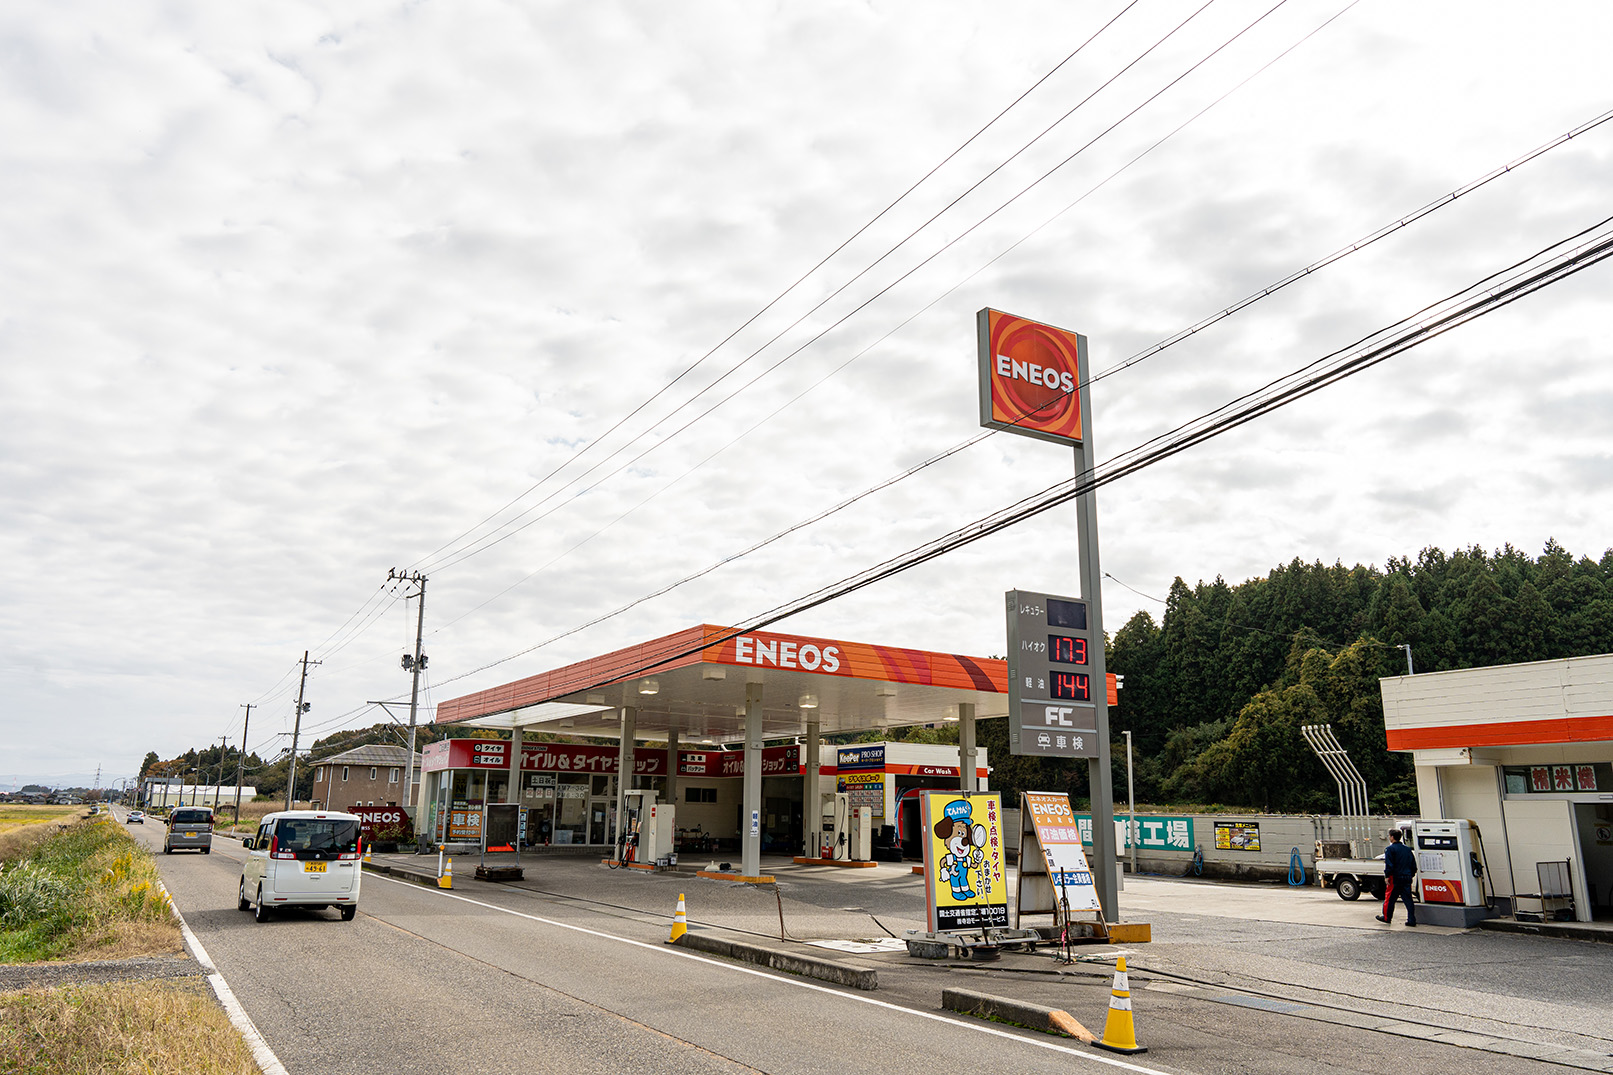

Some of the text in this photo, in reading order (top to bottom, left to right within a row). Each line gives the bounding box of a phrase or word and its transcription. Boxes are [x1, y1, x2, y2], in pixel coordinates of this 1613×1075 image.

[997, 354, 1074, 393] ENEOS
[735, 636, 840, 673] ENEOS
[1021, 638, 1086, 665] ハイオク 173
[1025, 674, 1088, 699] 軽油 144
[1045, 706, 1074, 726] FC
[1056, 735, 1084, 750] 車検
[935, 767, 952, 775] Wash
[1532, 766, 1596, 790] 精米機
[1032, 803, 1070, 816] ENEOS
[452, 813, 480, 827] 車検
[1036, 816, 1073, 824] CARD
[1041, 828, 1077, 840] 灯油価格
[983, 859, 992, 894] おまかせ
